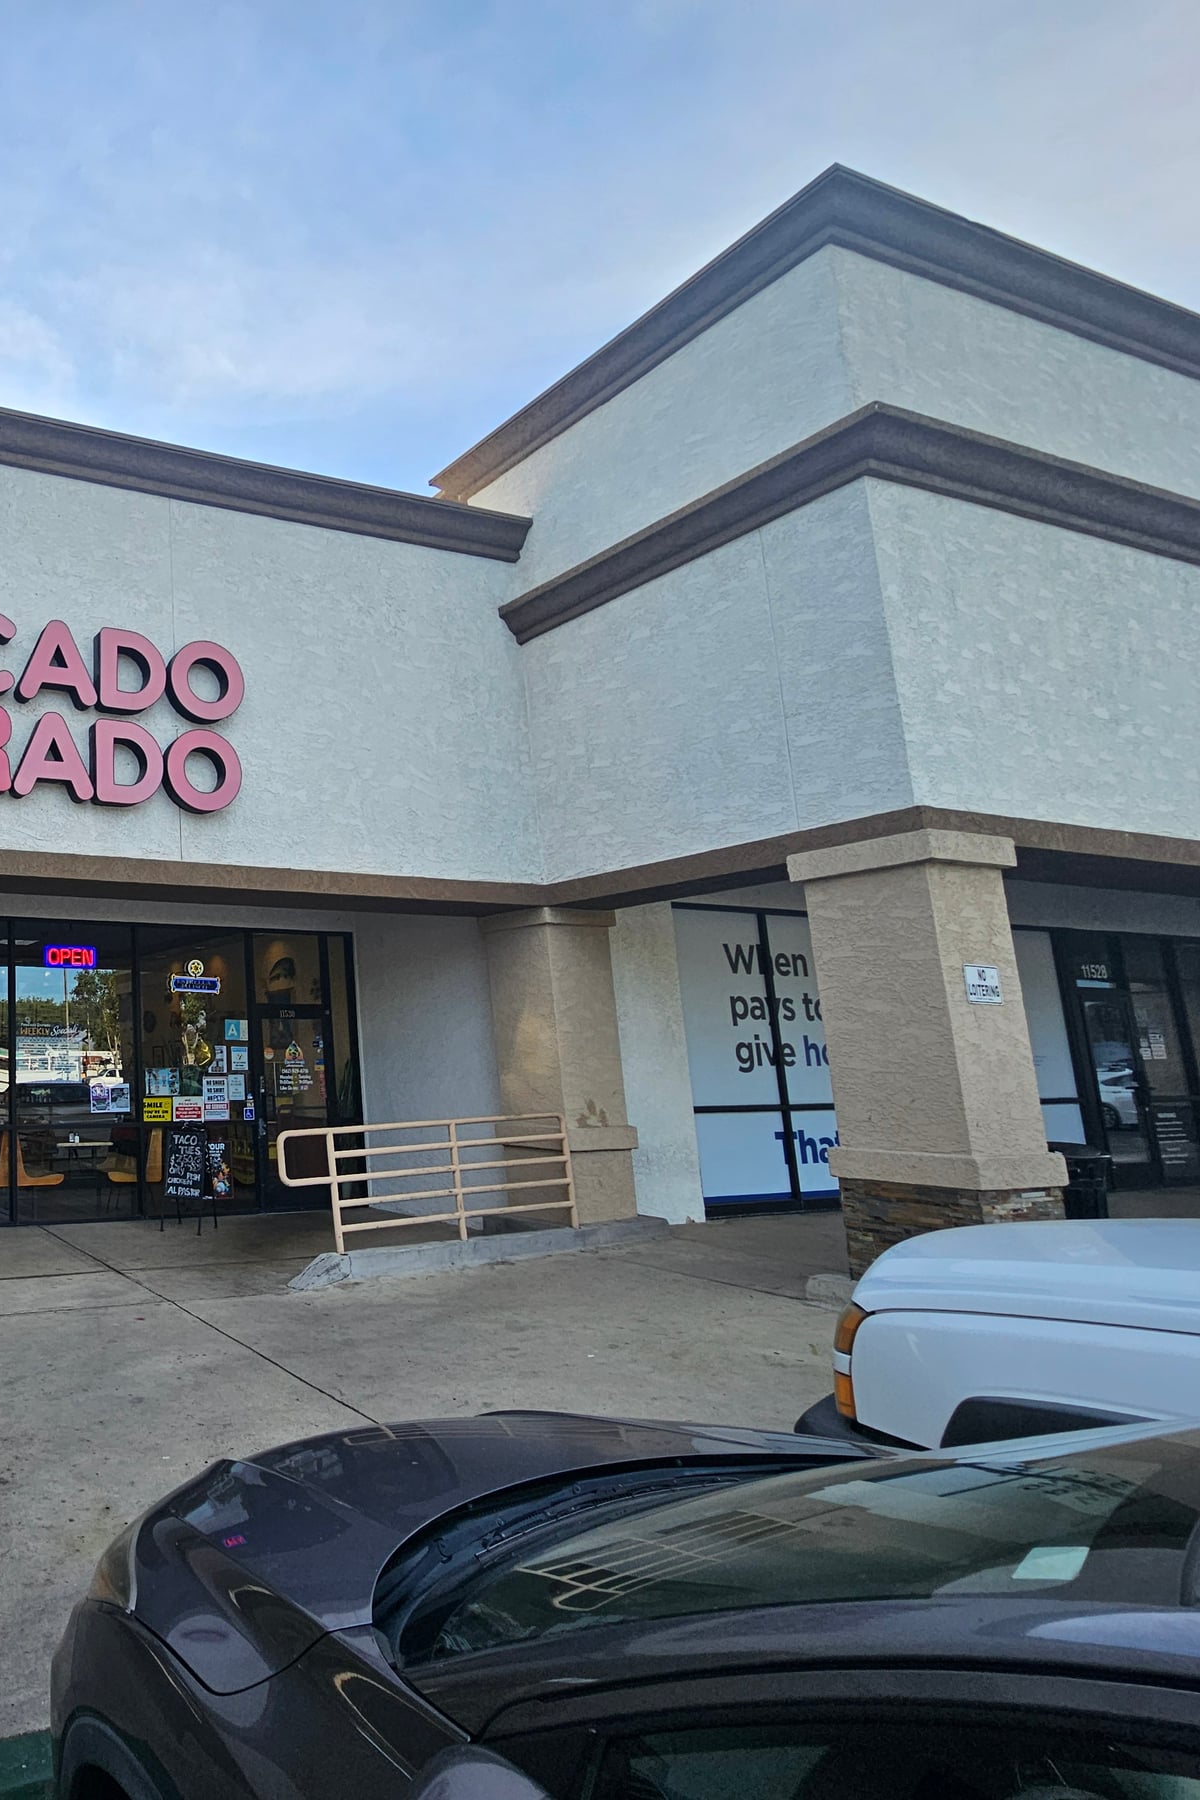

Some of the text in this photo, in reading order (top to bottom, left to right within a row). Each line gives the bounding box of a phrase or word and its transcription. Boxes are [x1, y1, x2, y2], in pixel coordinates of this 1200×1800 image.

[48, 948, 94, 966] OPEN
[977, 969, 987, 981] NO
[1081, 965, 1108, 979] 11528
[969, 984, 1000, 998] LOITERING
[21, 1027, 50, 1036] WEEKLY
[228, 1024, 238, 1036] A
[172, 1135, 198, 1146] TACO
[167, 1186, 177, 1194] AL
